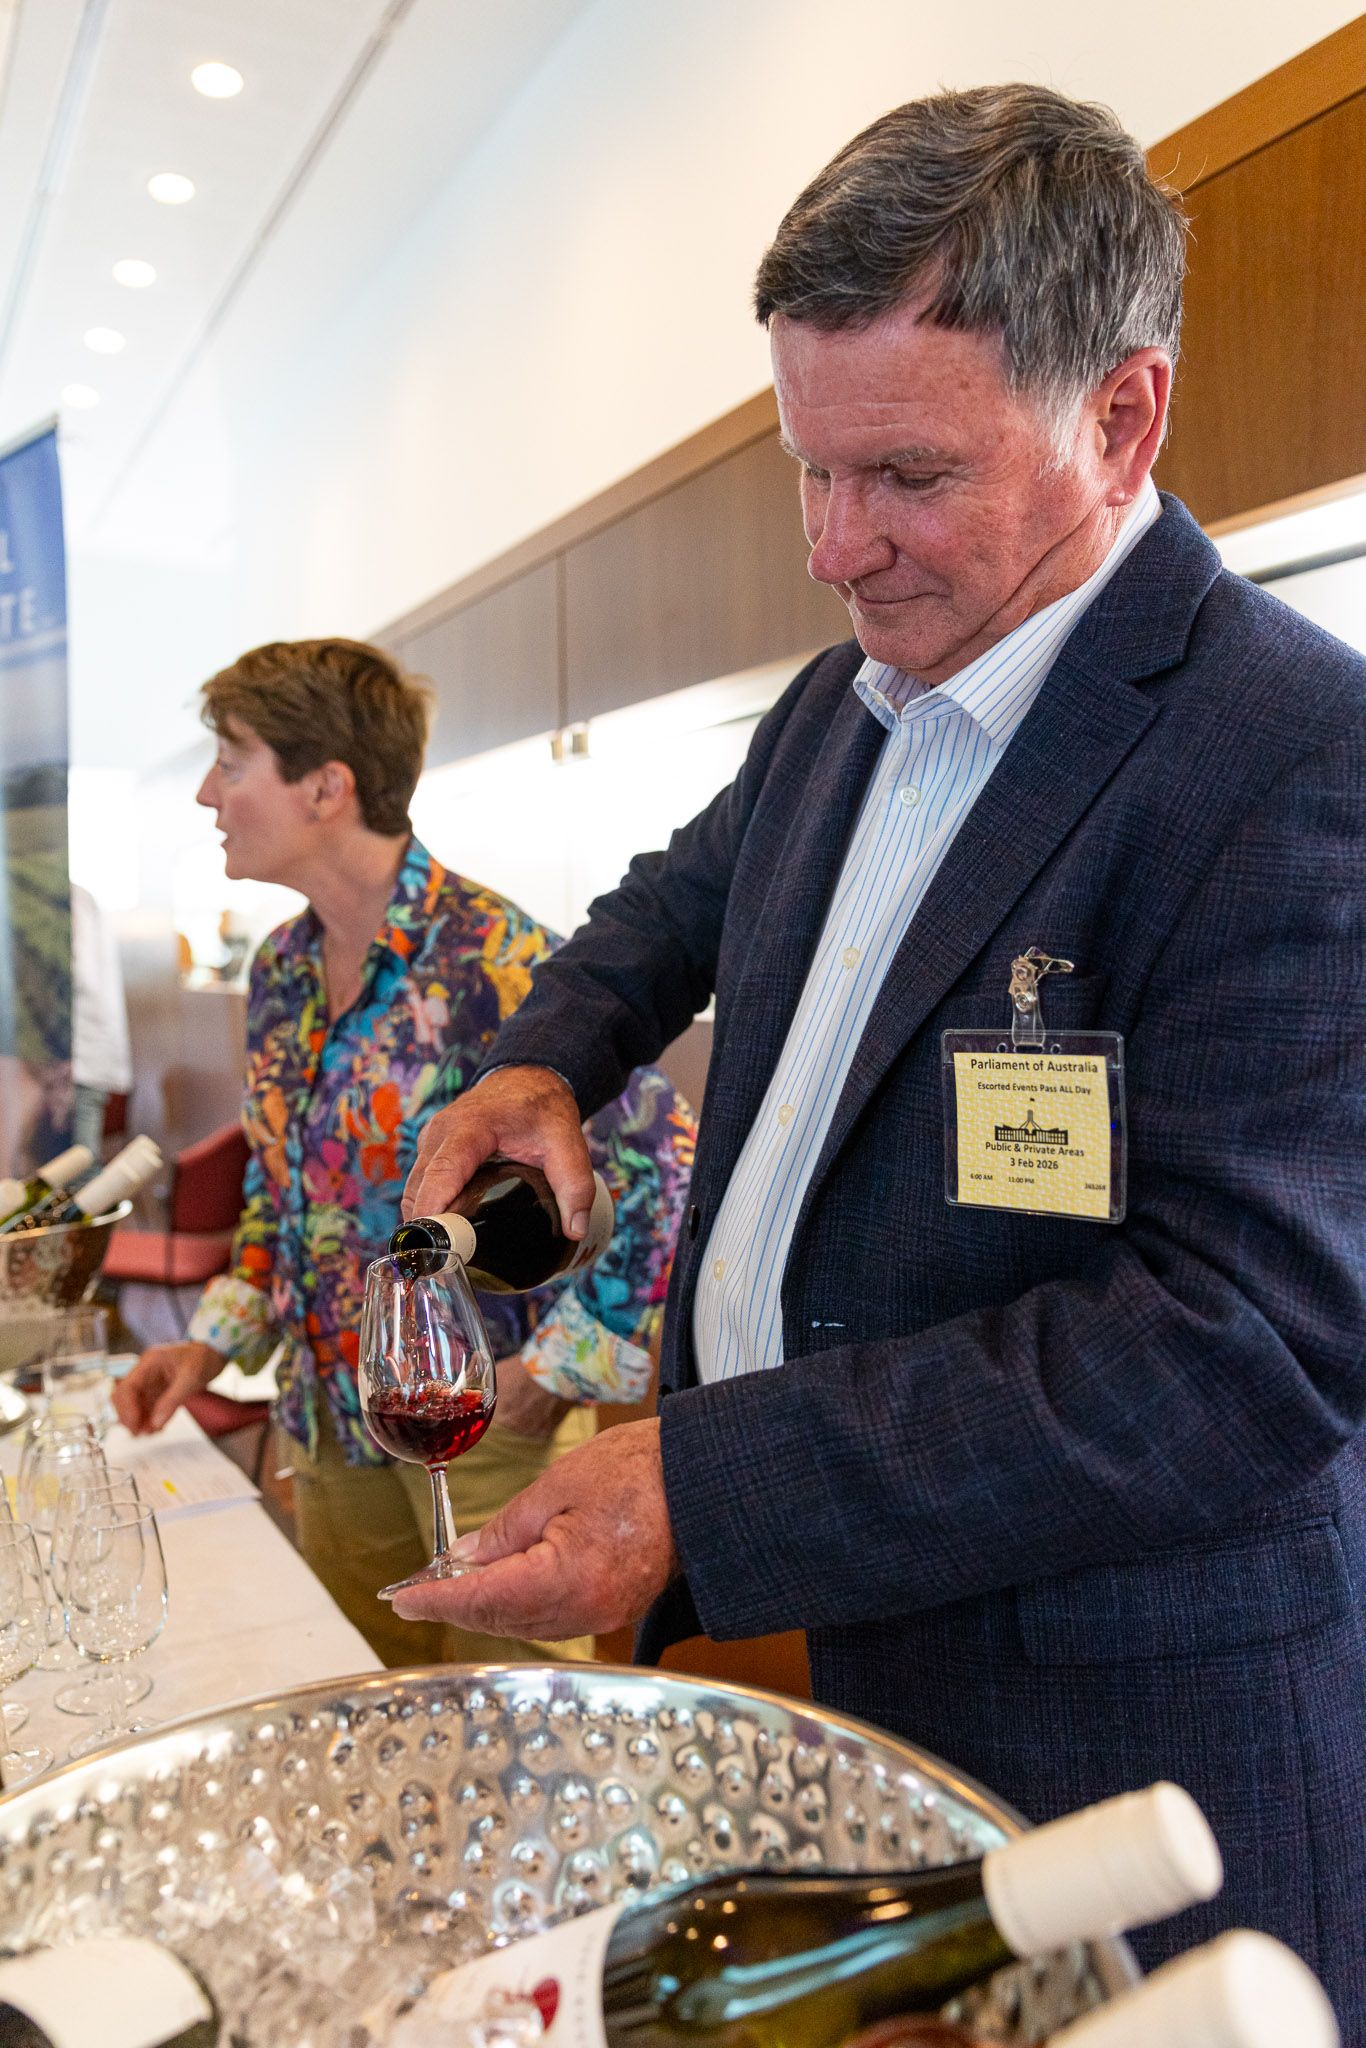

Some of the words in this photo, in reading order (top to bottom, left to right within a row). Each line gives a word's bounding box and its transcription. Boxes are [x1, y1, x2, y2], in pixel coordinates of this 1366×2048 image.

[970, 1059, 1030, 1071] Parliament
[1033, 1060, 1044, 1070] of
[1047, 1061, 1098, 1073] Australia
[978, 1082, 1010, 1090] Escorted
[1013, 1083, 1038, 1092] Events
[1040, 1084, 1057, 1092] Pass
[1059, 1085, 1072, 1093] ALL
[1075, 1086, 1091, 1095] Day
[985, 1142, 1012, 1152] Public
[1014, 1144, 1021, 1152] &
[1024, 1144, 1056, 1155] Private
[1058, 1146, 1084, 1156] Areas
[1010, 1158, 1016, 1167] 3
[1018, 1158, 1034, 1167] Feb
[1036, 1159, 1058, 1169] 2026
